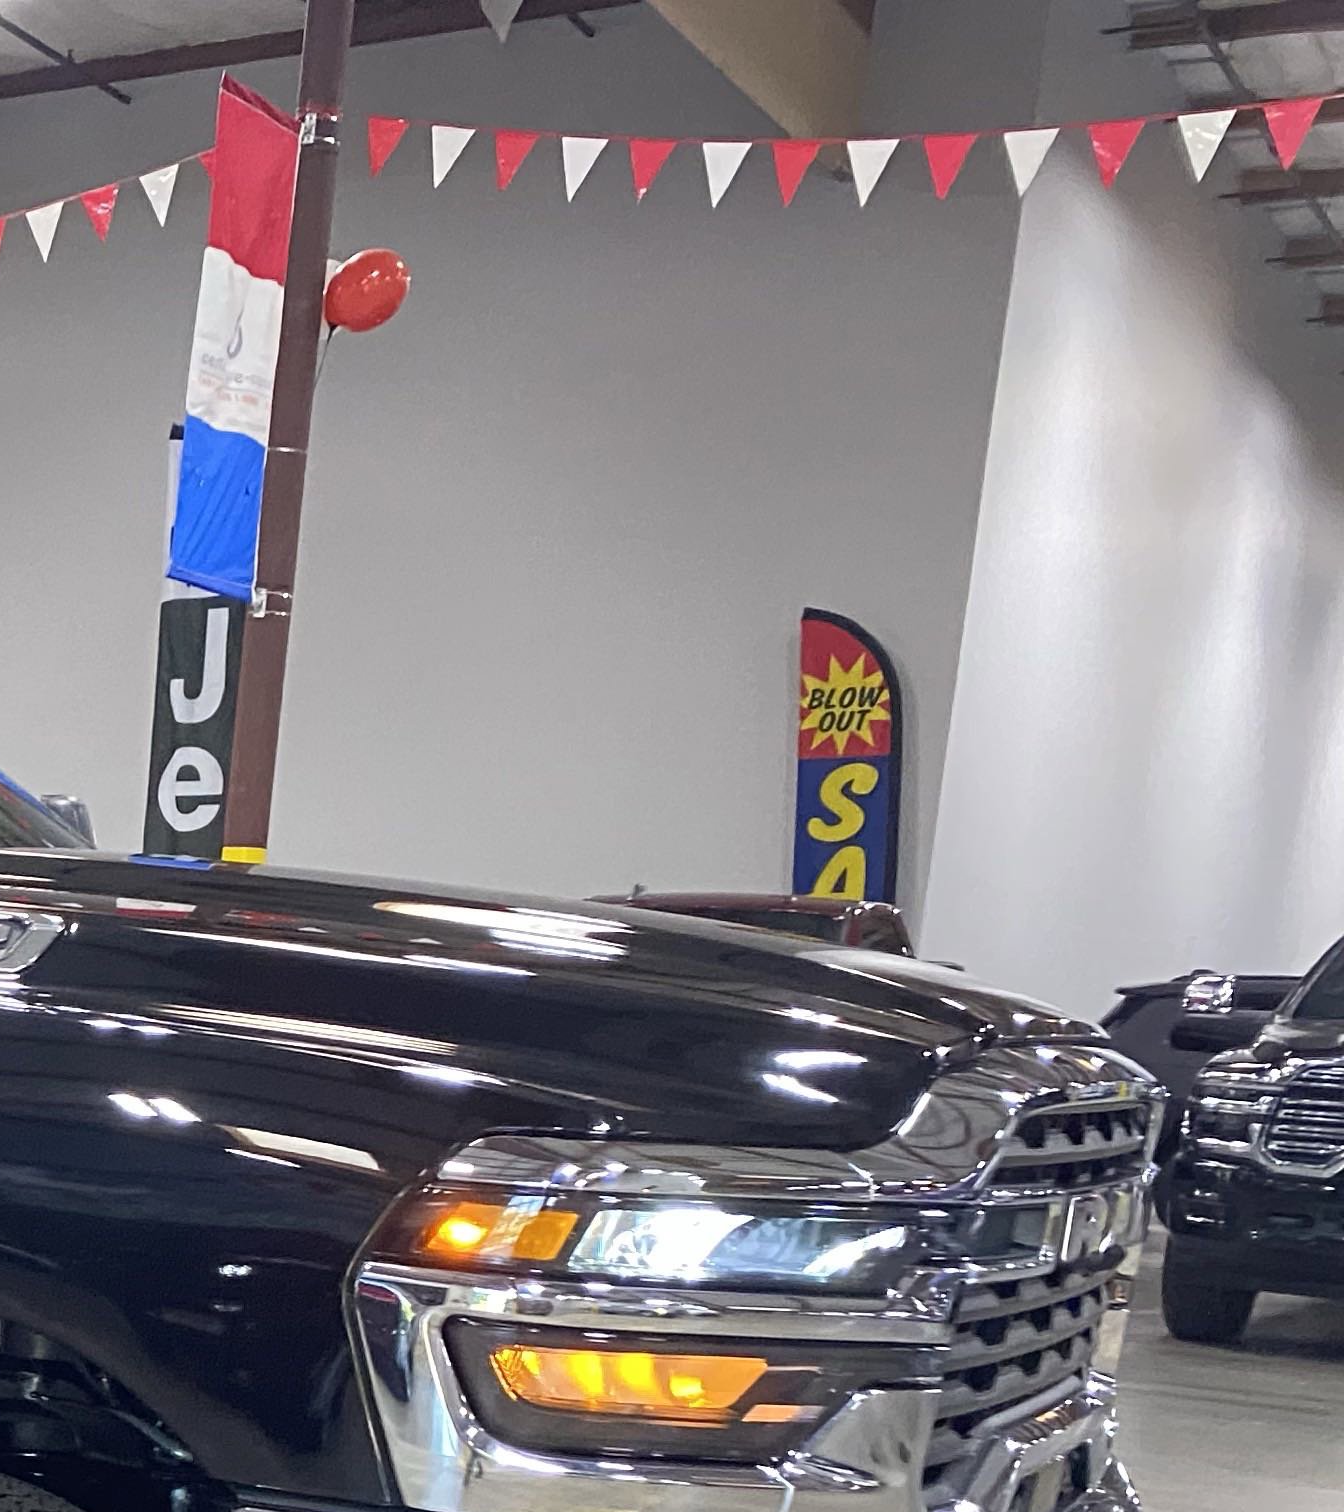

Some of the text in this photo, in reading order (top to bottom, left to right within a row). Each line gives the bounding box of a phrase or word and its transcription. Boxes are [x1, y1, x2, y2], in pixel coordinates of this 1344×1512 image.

[158, 607, 229, 832] Je
[808, 686, 885, 710] BLOW
[818, 709, 872, 733] OUT
[807, 762, 879, 901] SA
